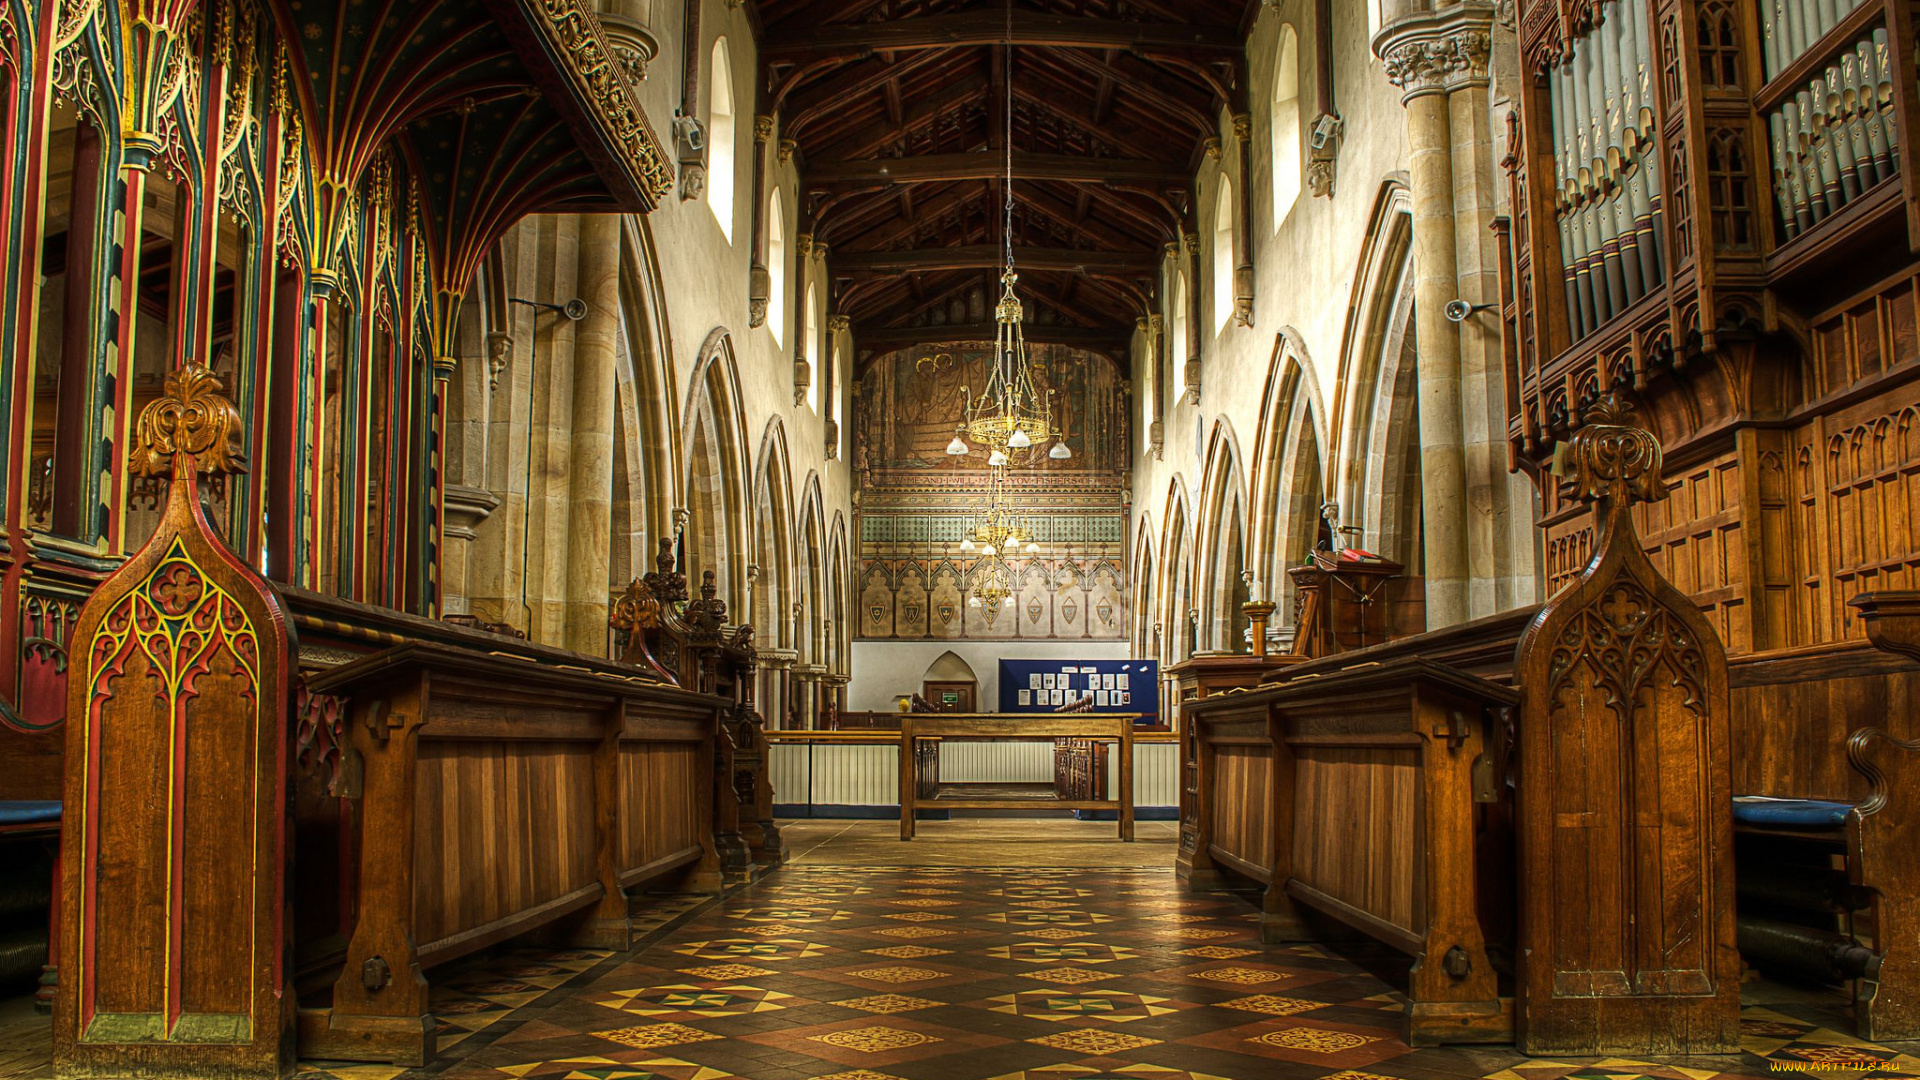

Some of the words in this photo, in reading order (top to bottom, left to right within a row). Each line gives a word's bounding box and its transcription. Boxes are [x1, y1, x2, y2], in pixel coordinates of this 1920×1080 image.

[907, 476, 920, 484] ME
[923, 476, 943, 485] AND
[1036, 477, 1077, 485] FISHERS
[1080, 477, 1094, 485] OF
